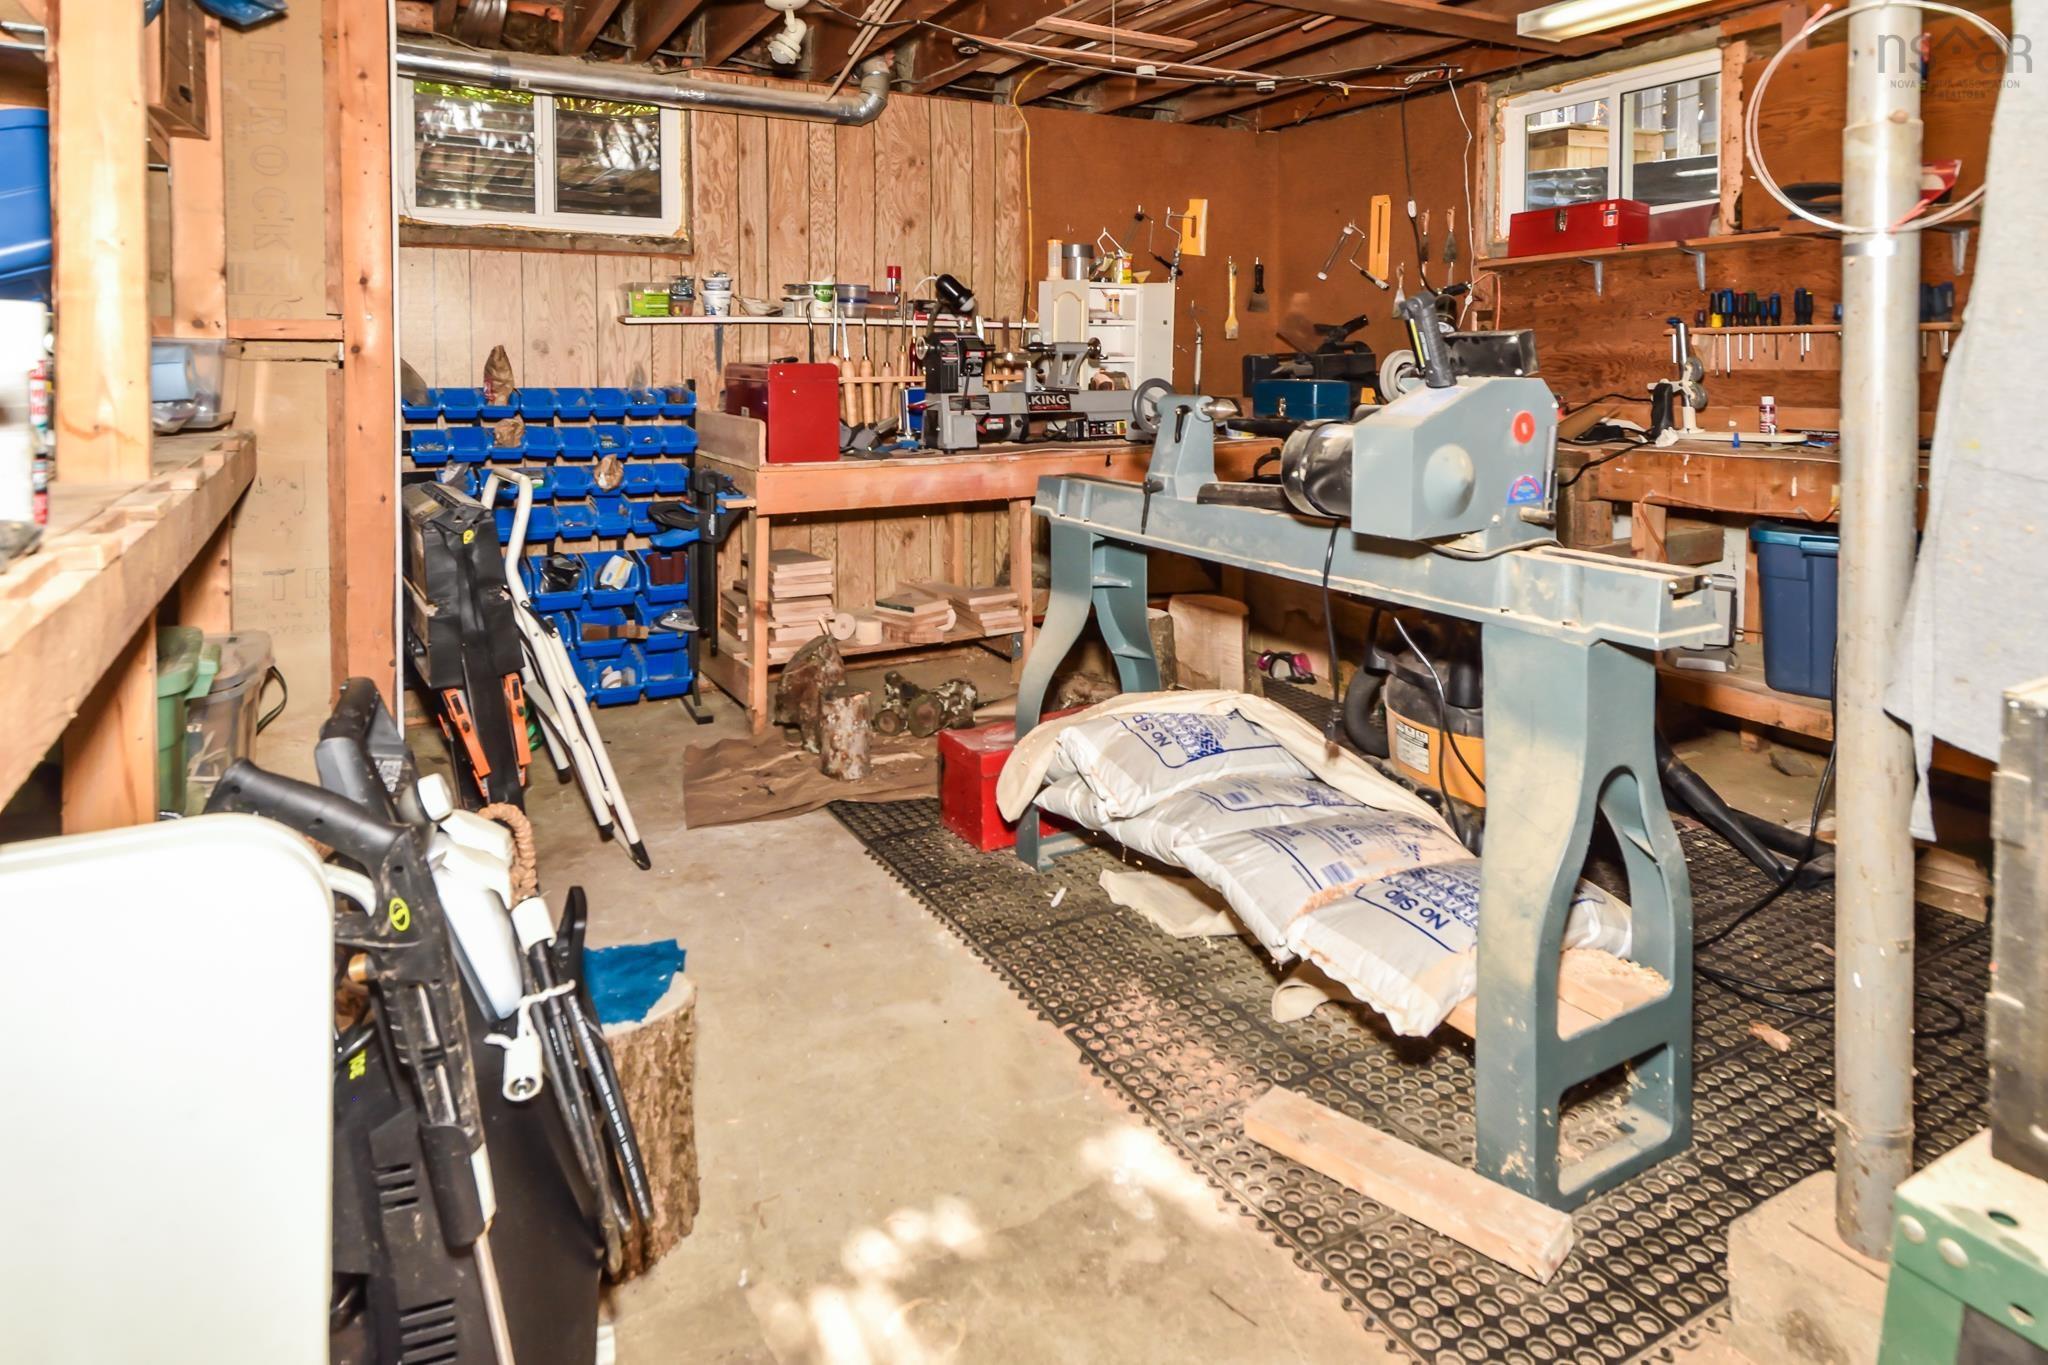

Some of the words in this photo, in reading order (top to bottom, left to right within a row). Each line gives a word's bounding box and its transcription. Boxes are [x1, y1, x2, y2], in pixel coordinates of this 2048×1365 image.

[1151, 731, 1172, 747] No
[1384, 889, 1419, 911] Slip
[1419, 907, 1450, 930] No
